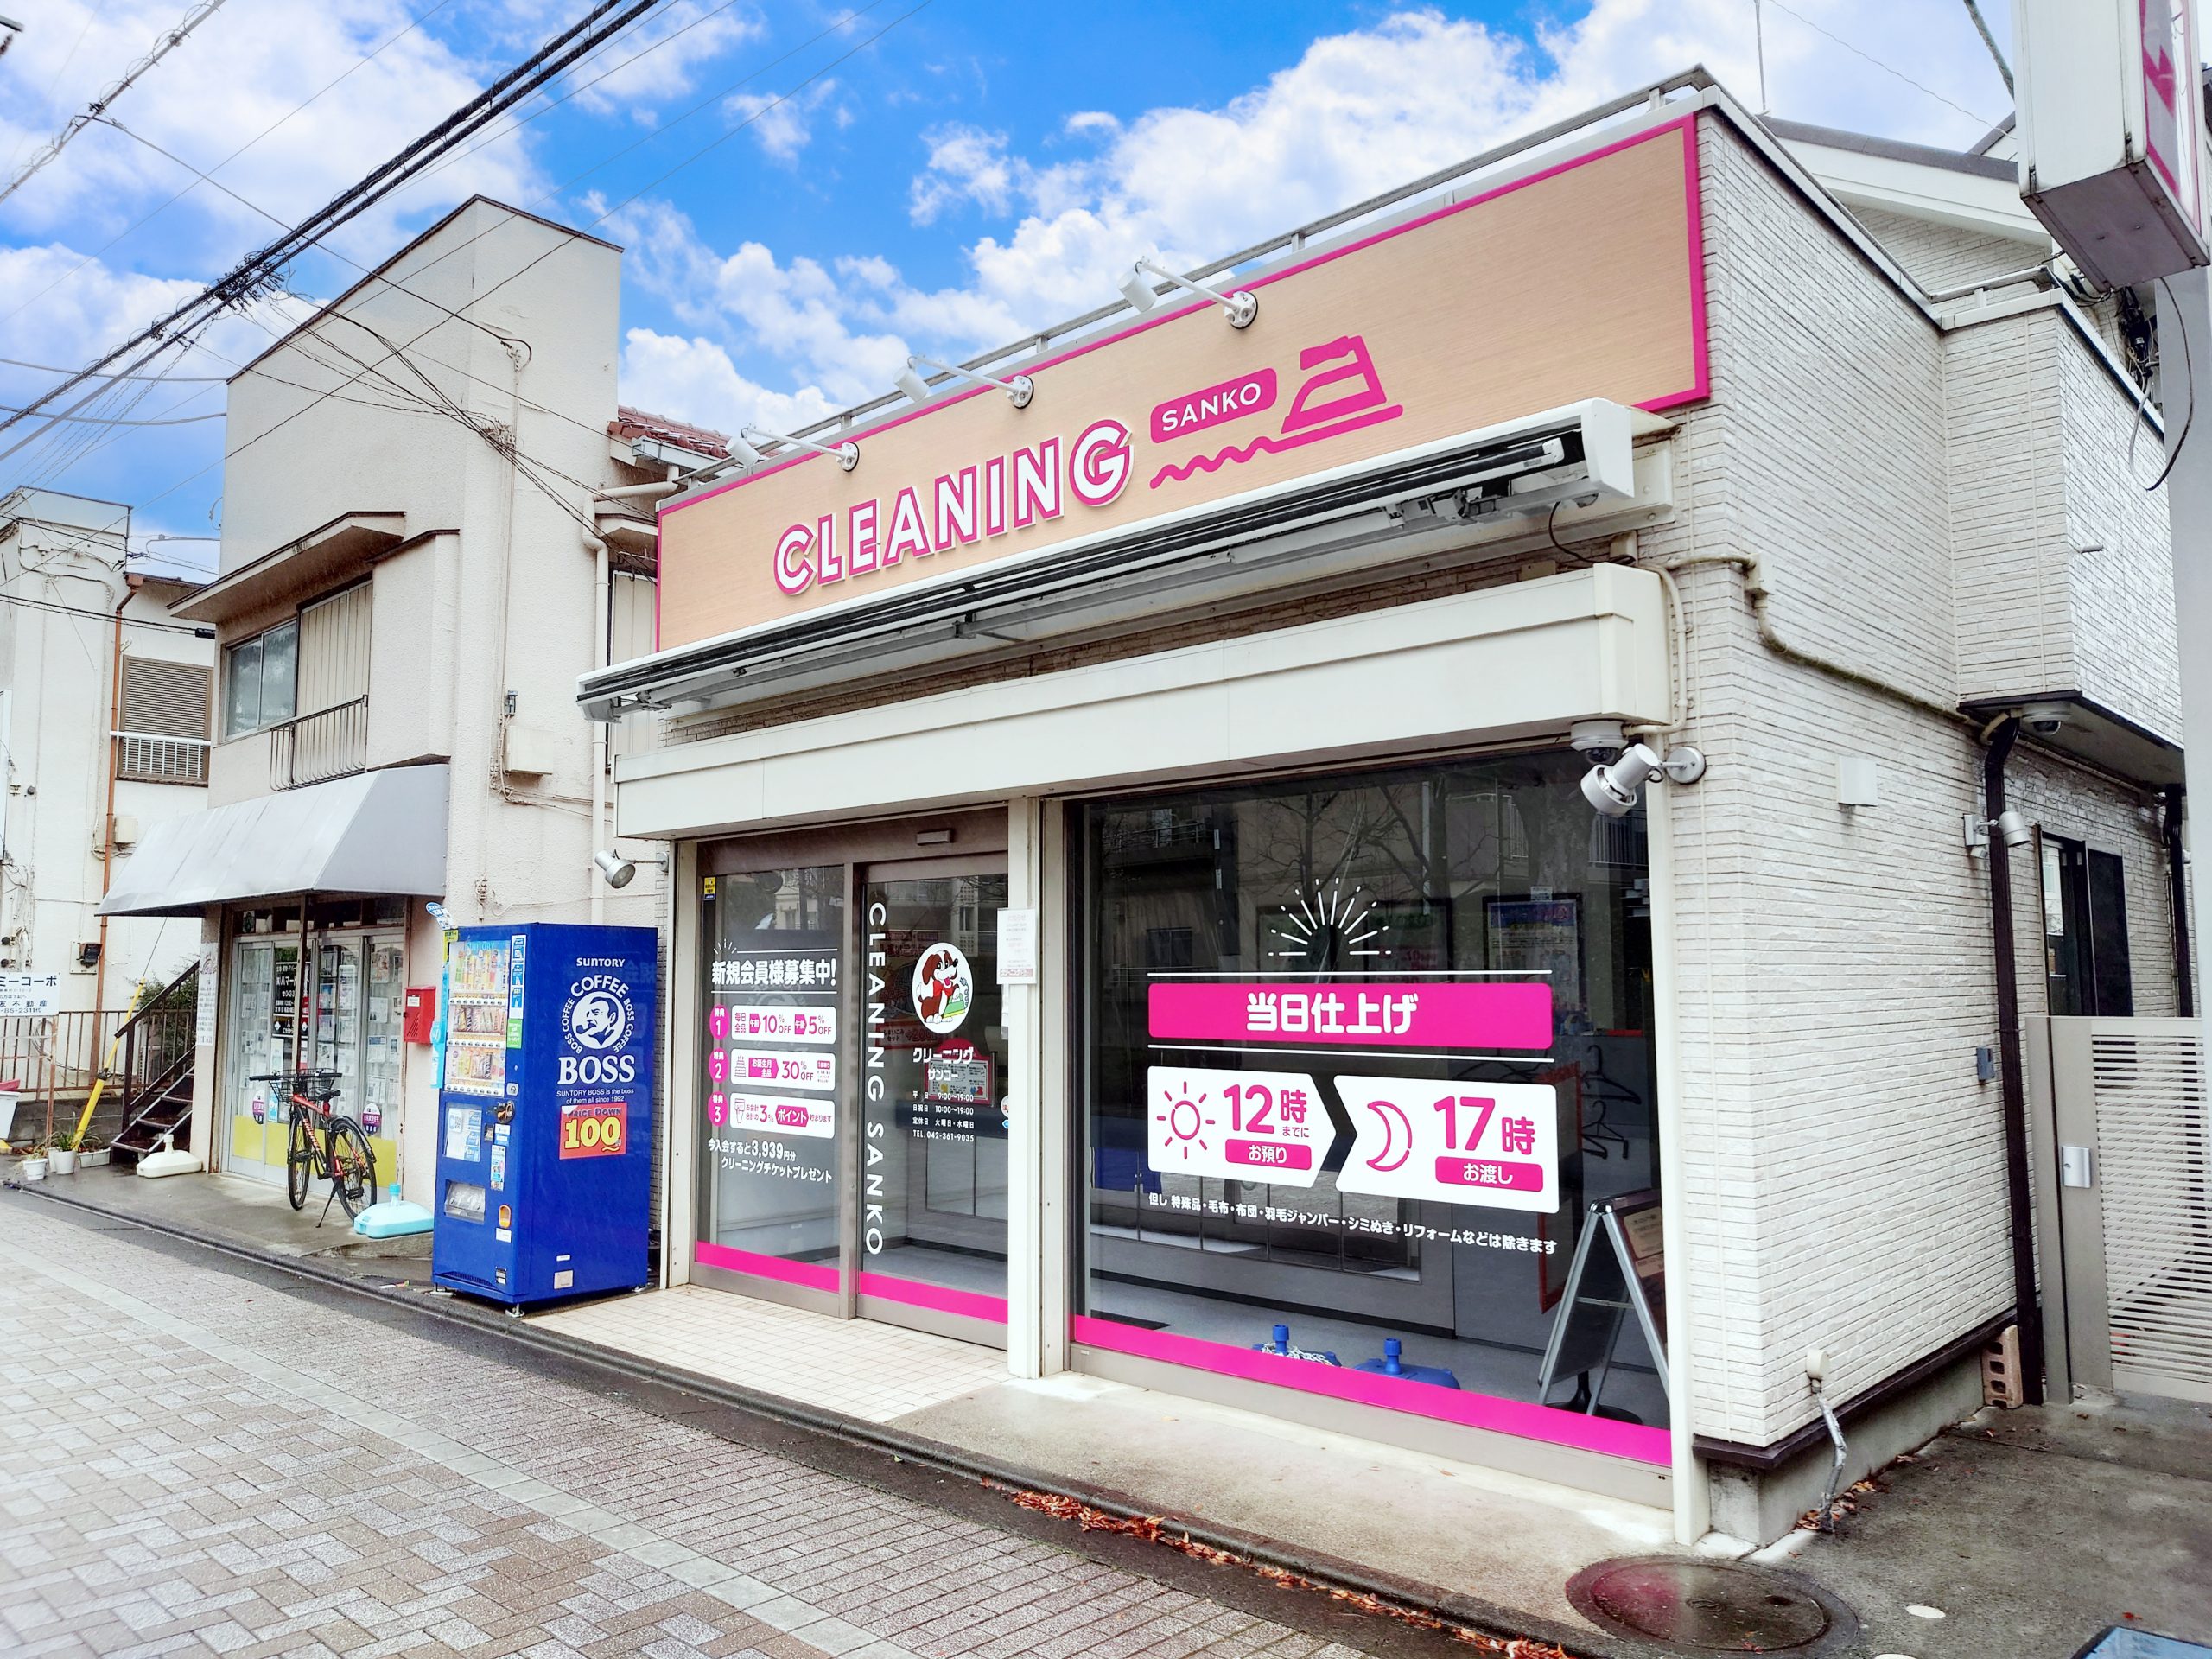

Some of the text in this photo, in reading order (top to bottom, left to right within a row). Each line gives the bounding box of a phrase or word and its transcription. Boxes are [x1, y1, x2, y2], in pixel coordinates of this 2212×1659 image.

[1160, 382, 1262, 433] SANKO
[773, 418, 1133, 596] CLEANING
[576, 957, 626, 968] SUNTORY
[711, 958, 836, 987] 新規会員様募集中!
[570, 975, 630, 998] COFFEE
[1247, 992, 1419, 1034] 当日仕上げ
[561, 998, 583, 1054] BOSS COFFEE
[613, 998, 635, 1053] BOSS COFFEE
[715, 1020, 721, 1036] 1
[912, 1046, 974, 1064] クリーニング
[557, 1054, 635, 1085] BOSS
[715, 1063, 722, 1079] 2
[866, 902, 887, 1255] CLEANING SANKO
[928, 1069, 958, 1081] サンコー
[714, 1106, 721, 1122] 3
[777, 1109, 807, 1124] ポイント
[912, 1117, 929, 1126] 定休日
[564, 1116, 621, 1149] 100
[1282, 1126, 1309, 1138] までに
[1248, 1145, 1287, 1164] お預り
[721, 1156, 832, 1184] クリーニングチケットプレゼント
[1463, 1163, 1513, 1185] お渡し
[1148, 1192, 1167, 1206] 但し
